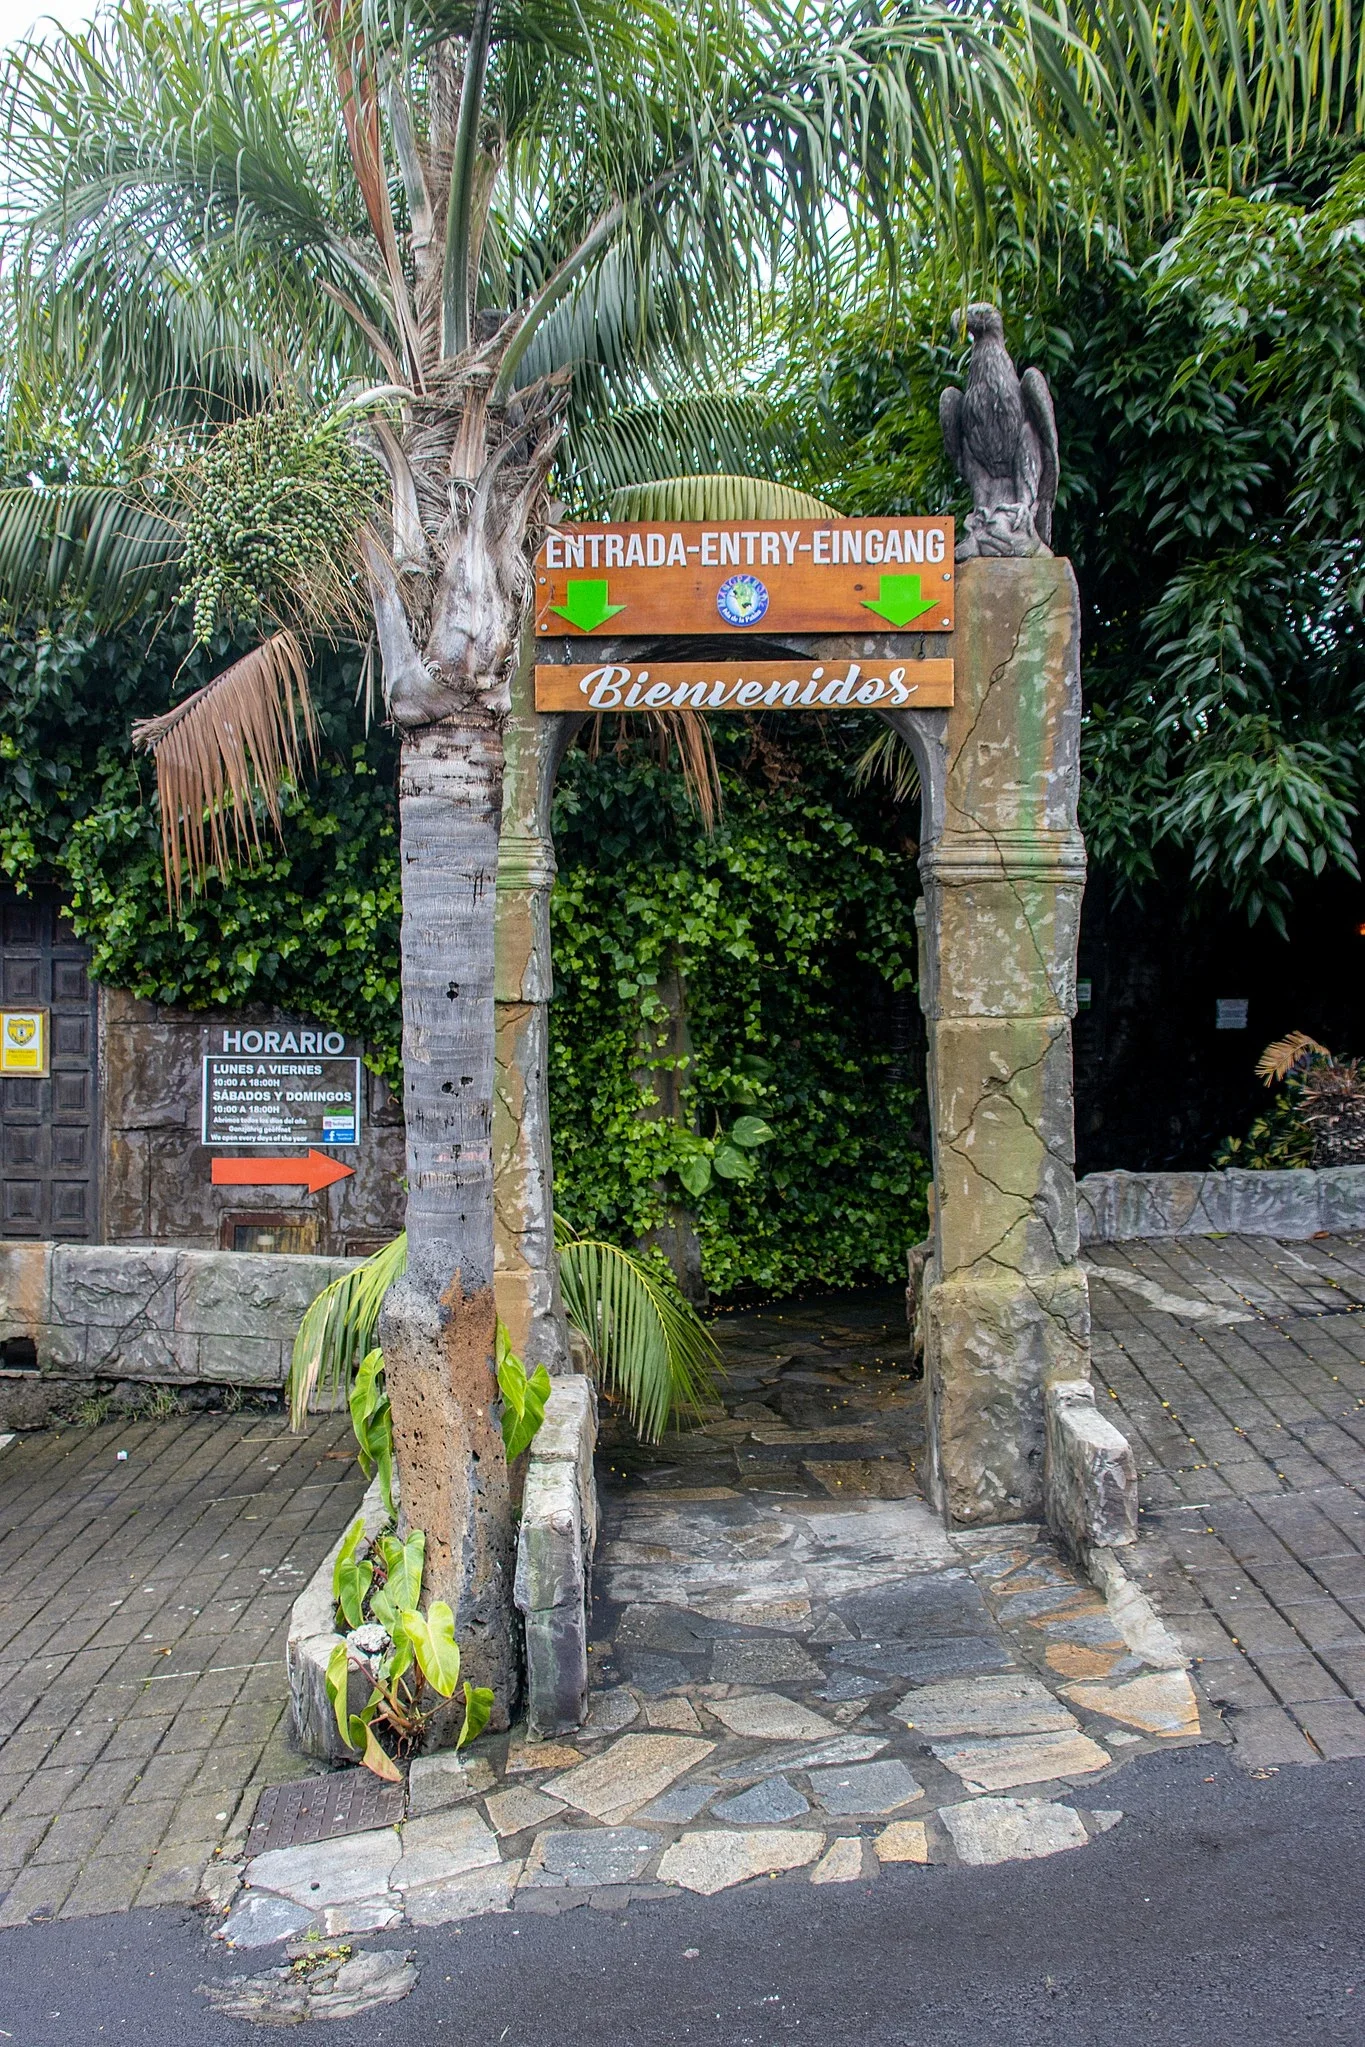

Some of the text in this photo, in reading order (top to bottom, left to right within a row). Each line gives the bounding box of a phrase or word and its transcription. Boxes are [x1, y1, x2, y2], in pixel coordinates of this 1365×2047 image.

[579, 664, 918, 709] Bienvenidos
[222, 1030, 345, 1054] HORARIO
[213, 1064, 322, 1075] LUNES A VIERNES
[213, 1078, 280, 1087] 10:00 A 18:00H
[213, 1089, 352, 1102] SÁBADOS Y DOMINGOS
[213, 1105, 280, 1114] 10:00 A 18:00H
[283, 1117, 294, 1125] del
[257, 1134, 273, 1142] days
[293, 1135, 308, 1143] year
